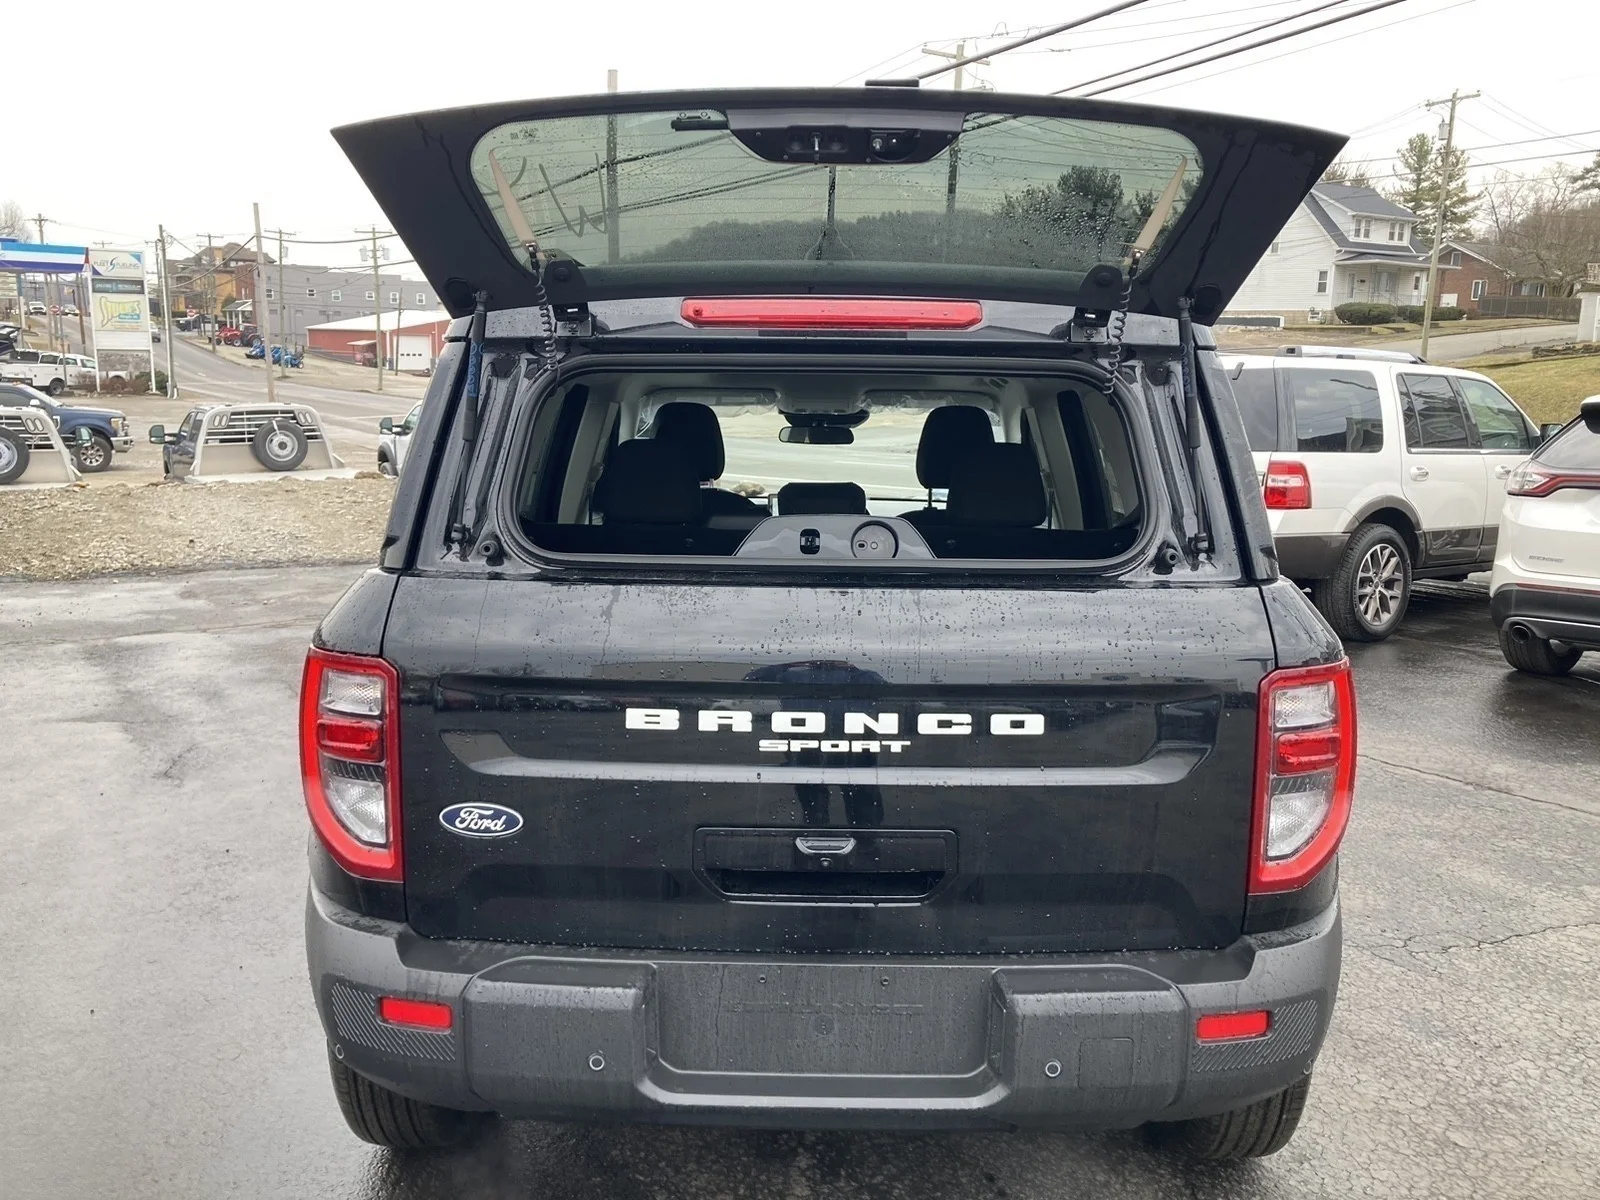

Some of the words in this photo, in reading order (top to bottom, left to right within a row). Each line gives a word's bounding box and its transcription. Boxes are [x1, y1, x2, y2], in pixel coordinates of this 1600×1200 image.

[1529, 555, 1565, 563] EDGE
[625, 707, 1046, 736] BRONCO
[758, 739, 911, 753] SPORT
[455, 807, 507, 831] Ford
